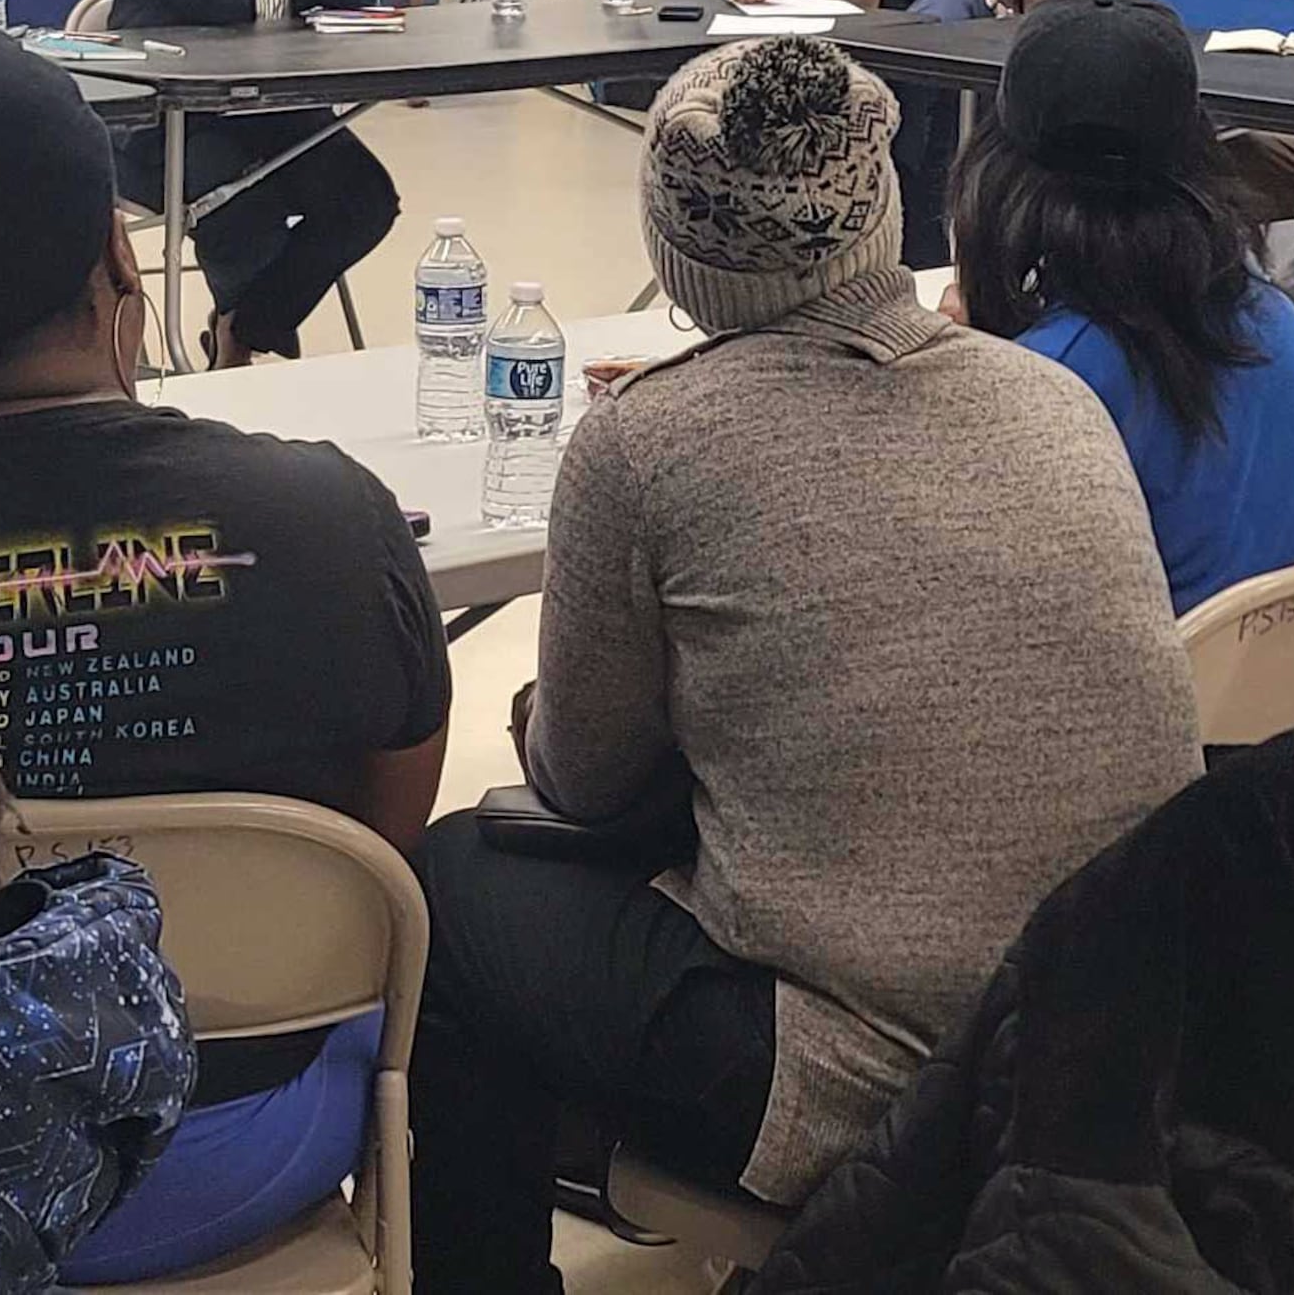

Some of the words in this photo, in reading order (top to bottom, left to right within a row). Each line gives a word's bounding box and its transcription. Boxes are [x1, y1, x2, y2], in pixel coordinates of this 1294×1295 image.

[516, 360, 548, 375] Pure
[519, 373, 546, 389] Life
[26, 661, 75, 679] NEW
[87, 647, 196, 674] ZEALAND
[26, 674, 162, 705] AUSTRALIA
[25, 705, 104, 727] JAPAN
[23, 727, 103, 746] SOUTH
[115, 717, 196, 739] KOREA
[19, 747, 93, 767] CHINA
[16, 771, 81, 789] INDIA
